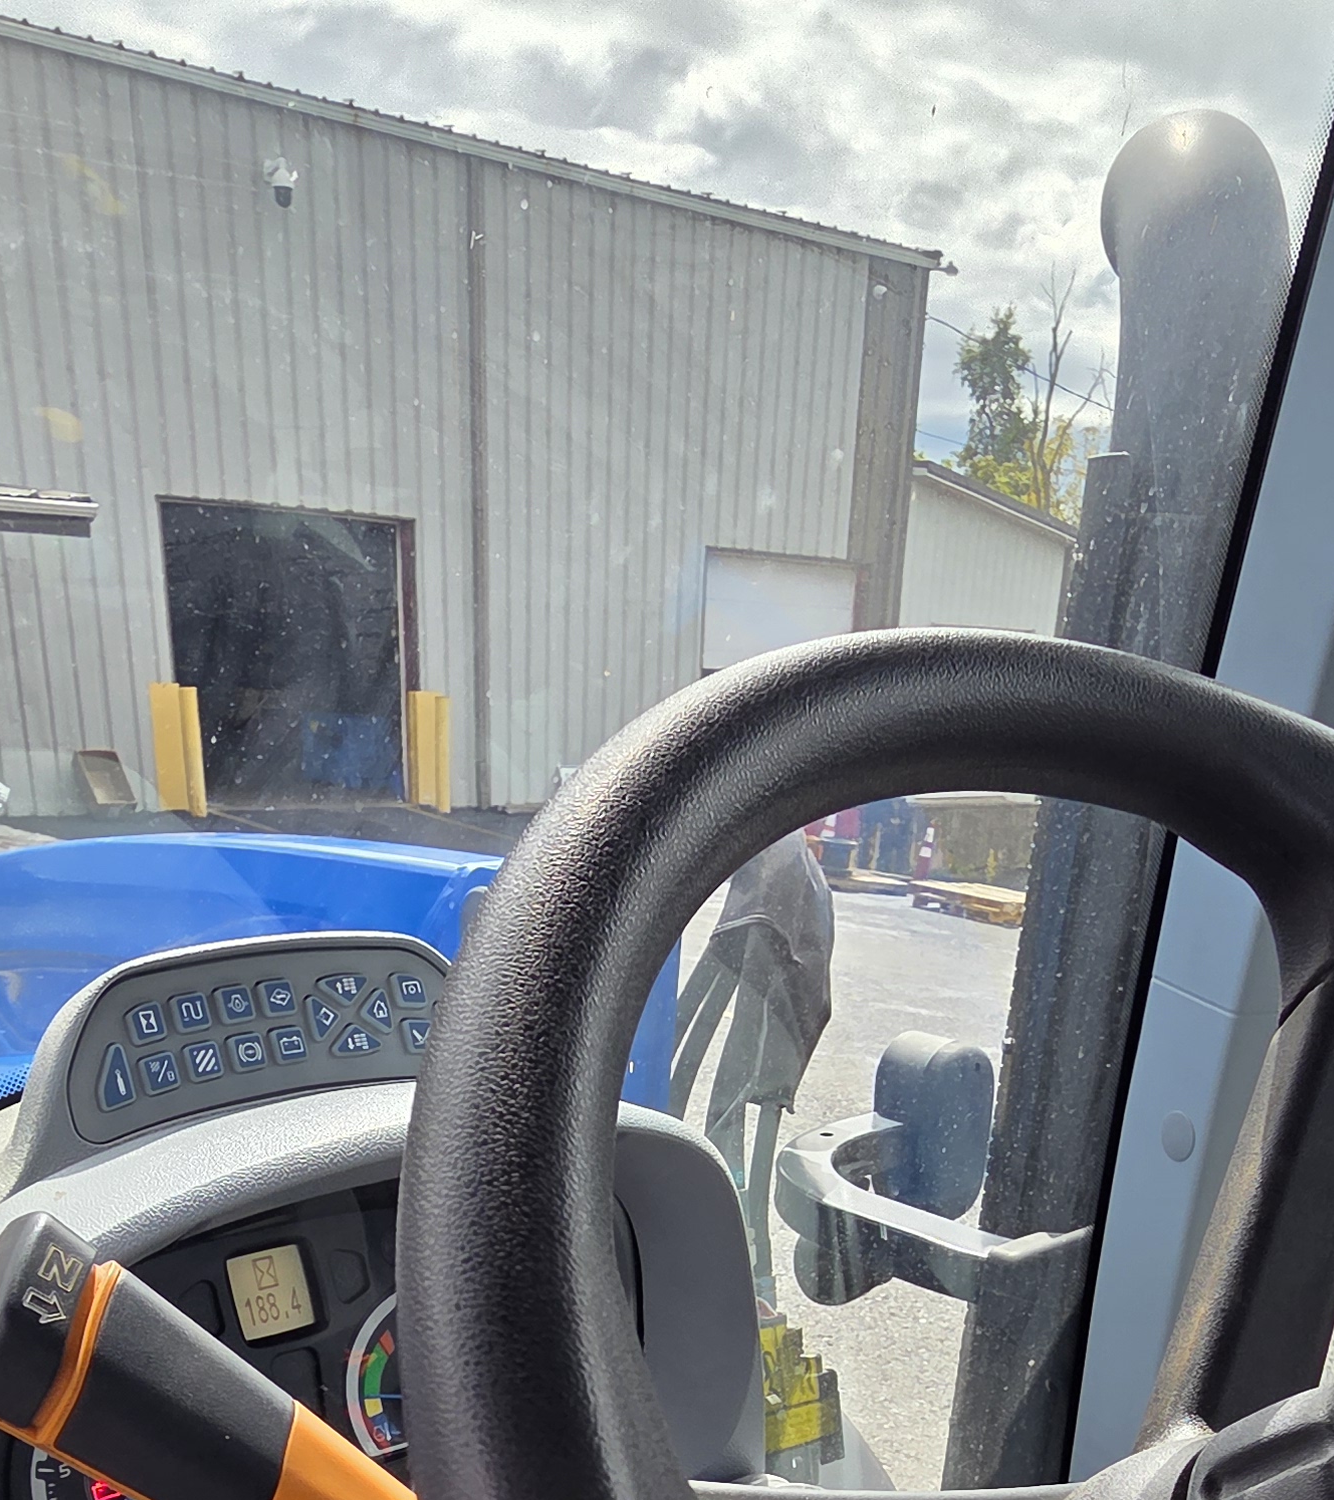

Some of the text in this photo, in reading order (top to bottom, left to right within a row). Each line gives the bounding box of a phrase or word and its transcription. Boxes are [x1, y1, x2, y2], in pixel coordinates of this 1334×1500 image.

[37, 1243, 84, 1292] N
[245, 1286, 302, 1326] 188.4
[58, 1463, 72, 1478] 5
